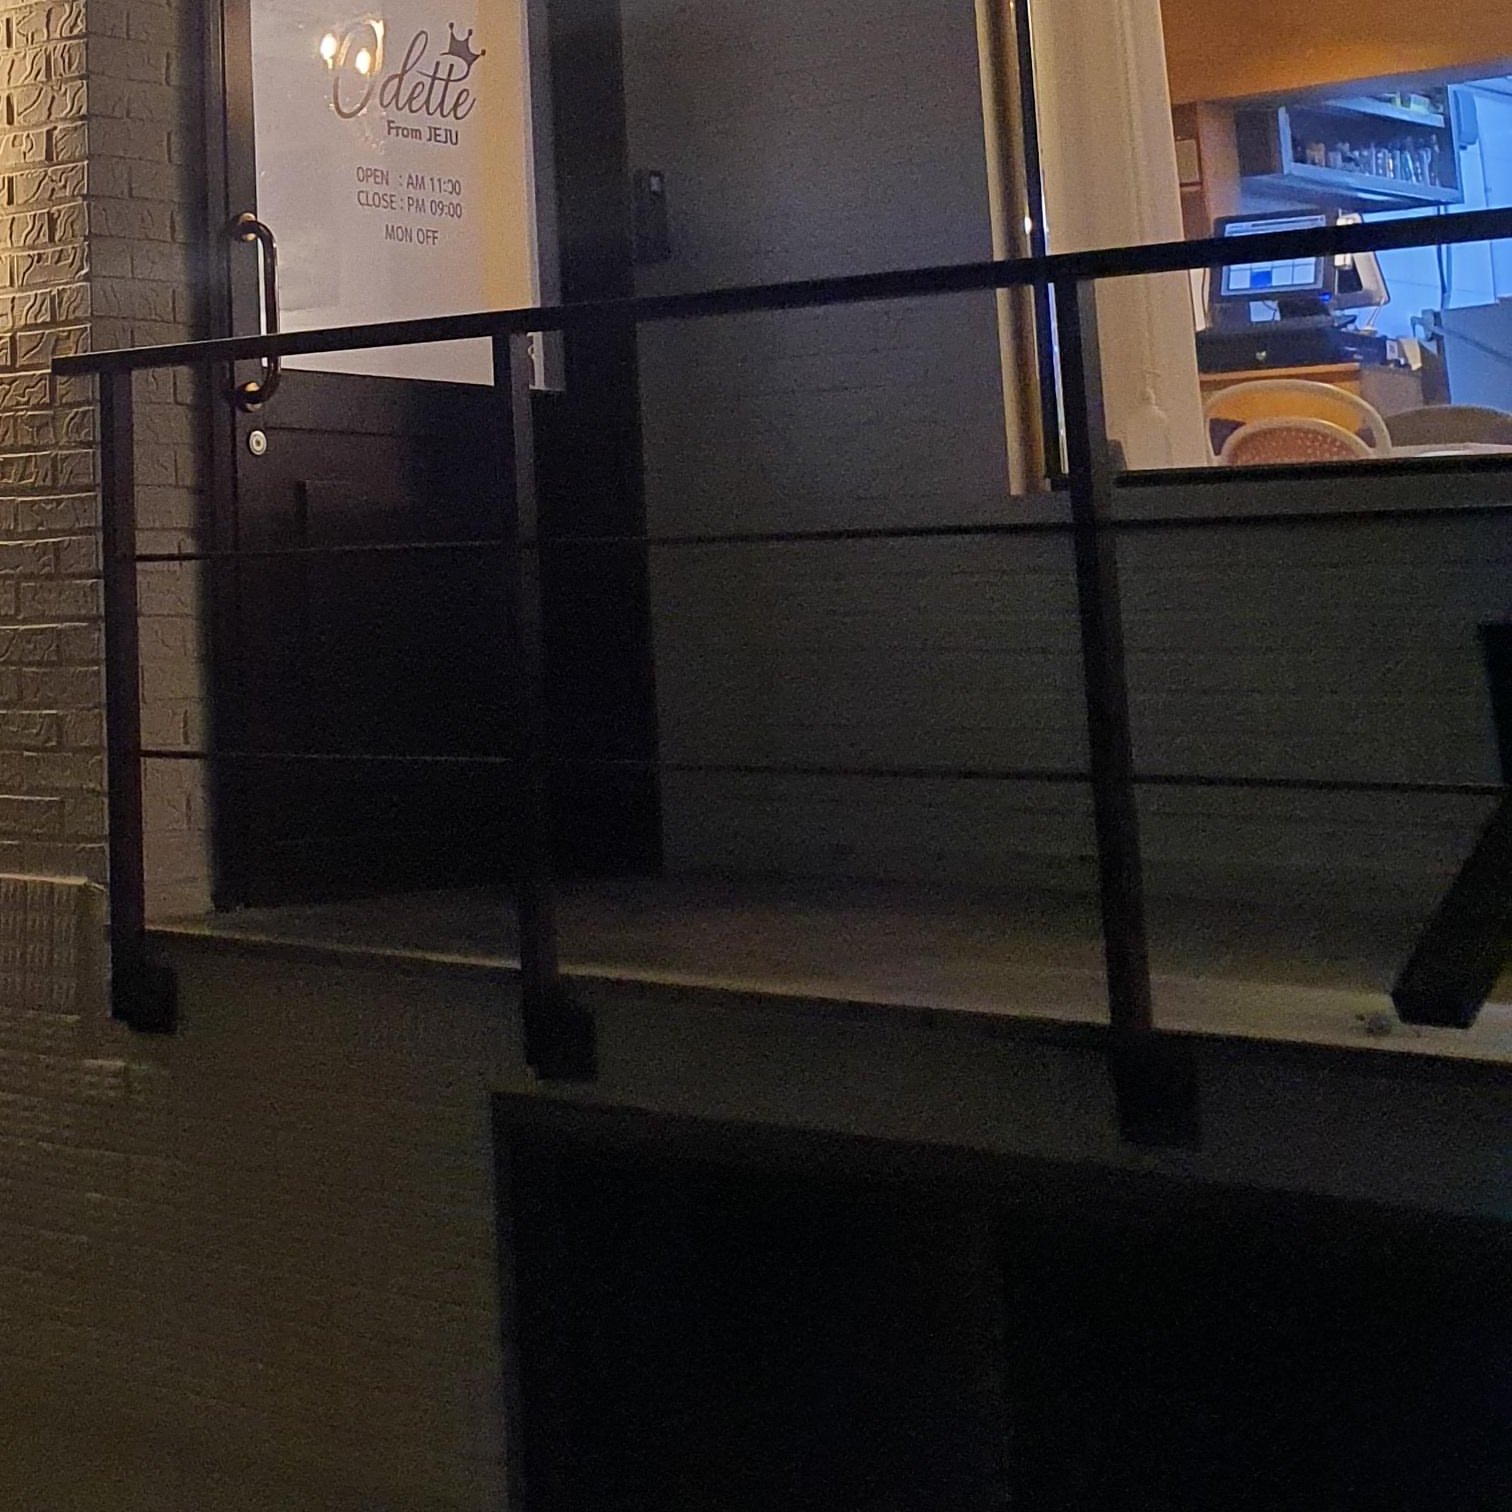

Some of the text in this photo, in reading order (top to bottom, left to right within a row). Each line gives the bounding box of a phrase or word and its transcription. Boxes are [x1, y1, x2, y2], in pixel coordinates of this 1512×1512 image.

[333, 23, 477, 121] Odette
[386, 119, 459, 146] From JEJU
[356, 166, 389, 187] OPEN
[406, 173, 426, 191] AM
[356, 189, 397, 211] CLOSE
[407, 196, 426, 214] PM
[429, 199, 463, 219] 09:00
[384, 223, 439, 246] MON OFF
